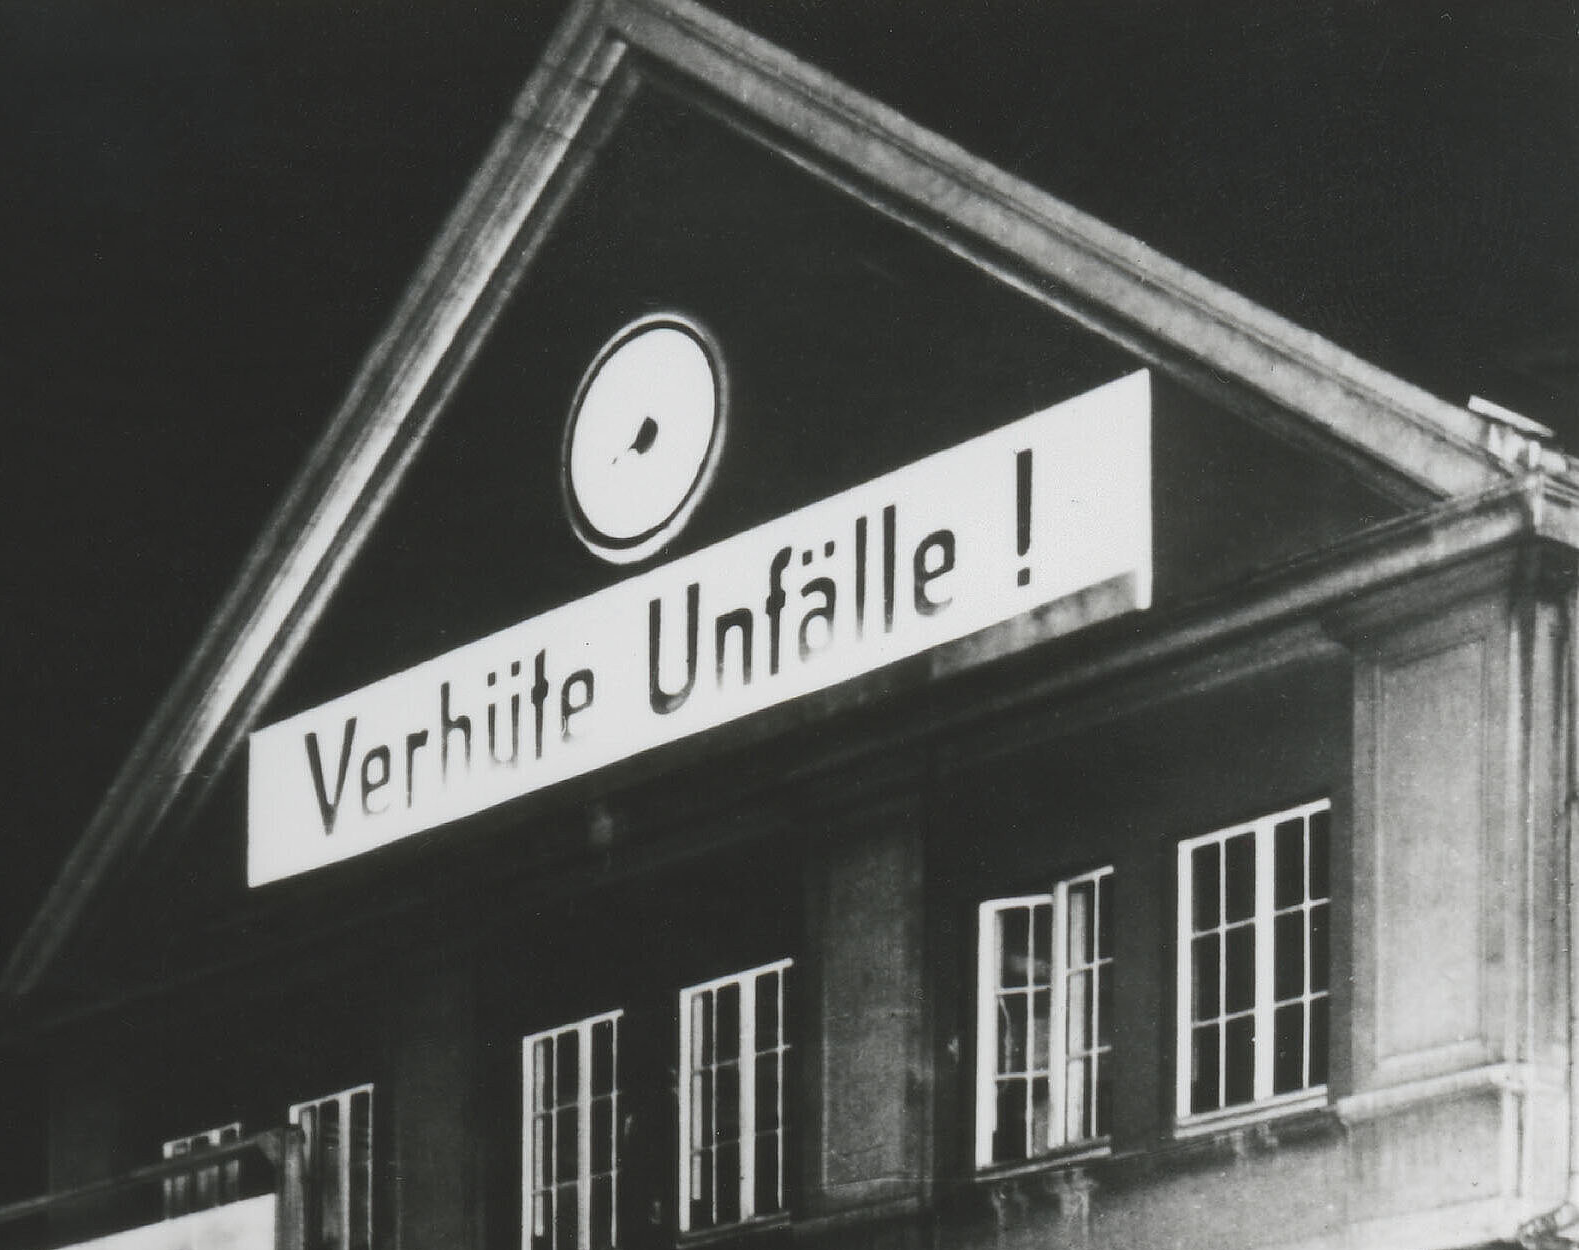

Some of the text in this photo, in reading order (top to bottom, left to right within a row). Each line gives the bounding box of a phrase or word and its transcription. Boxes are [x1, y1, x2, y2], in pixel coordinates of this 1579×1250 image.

[305, 448, 1034, 836] Verhüte Unfälle !
